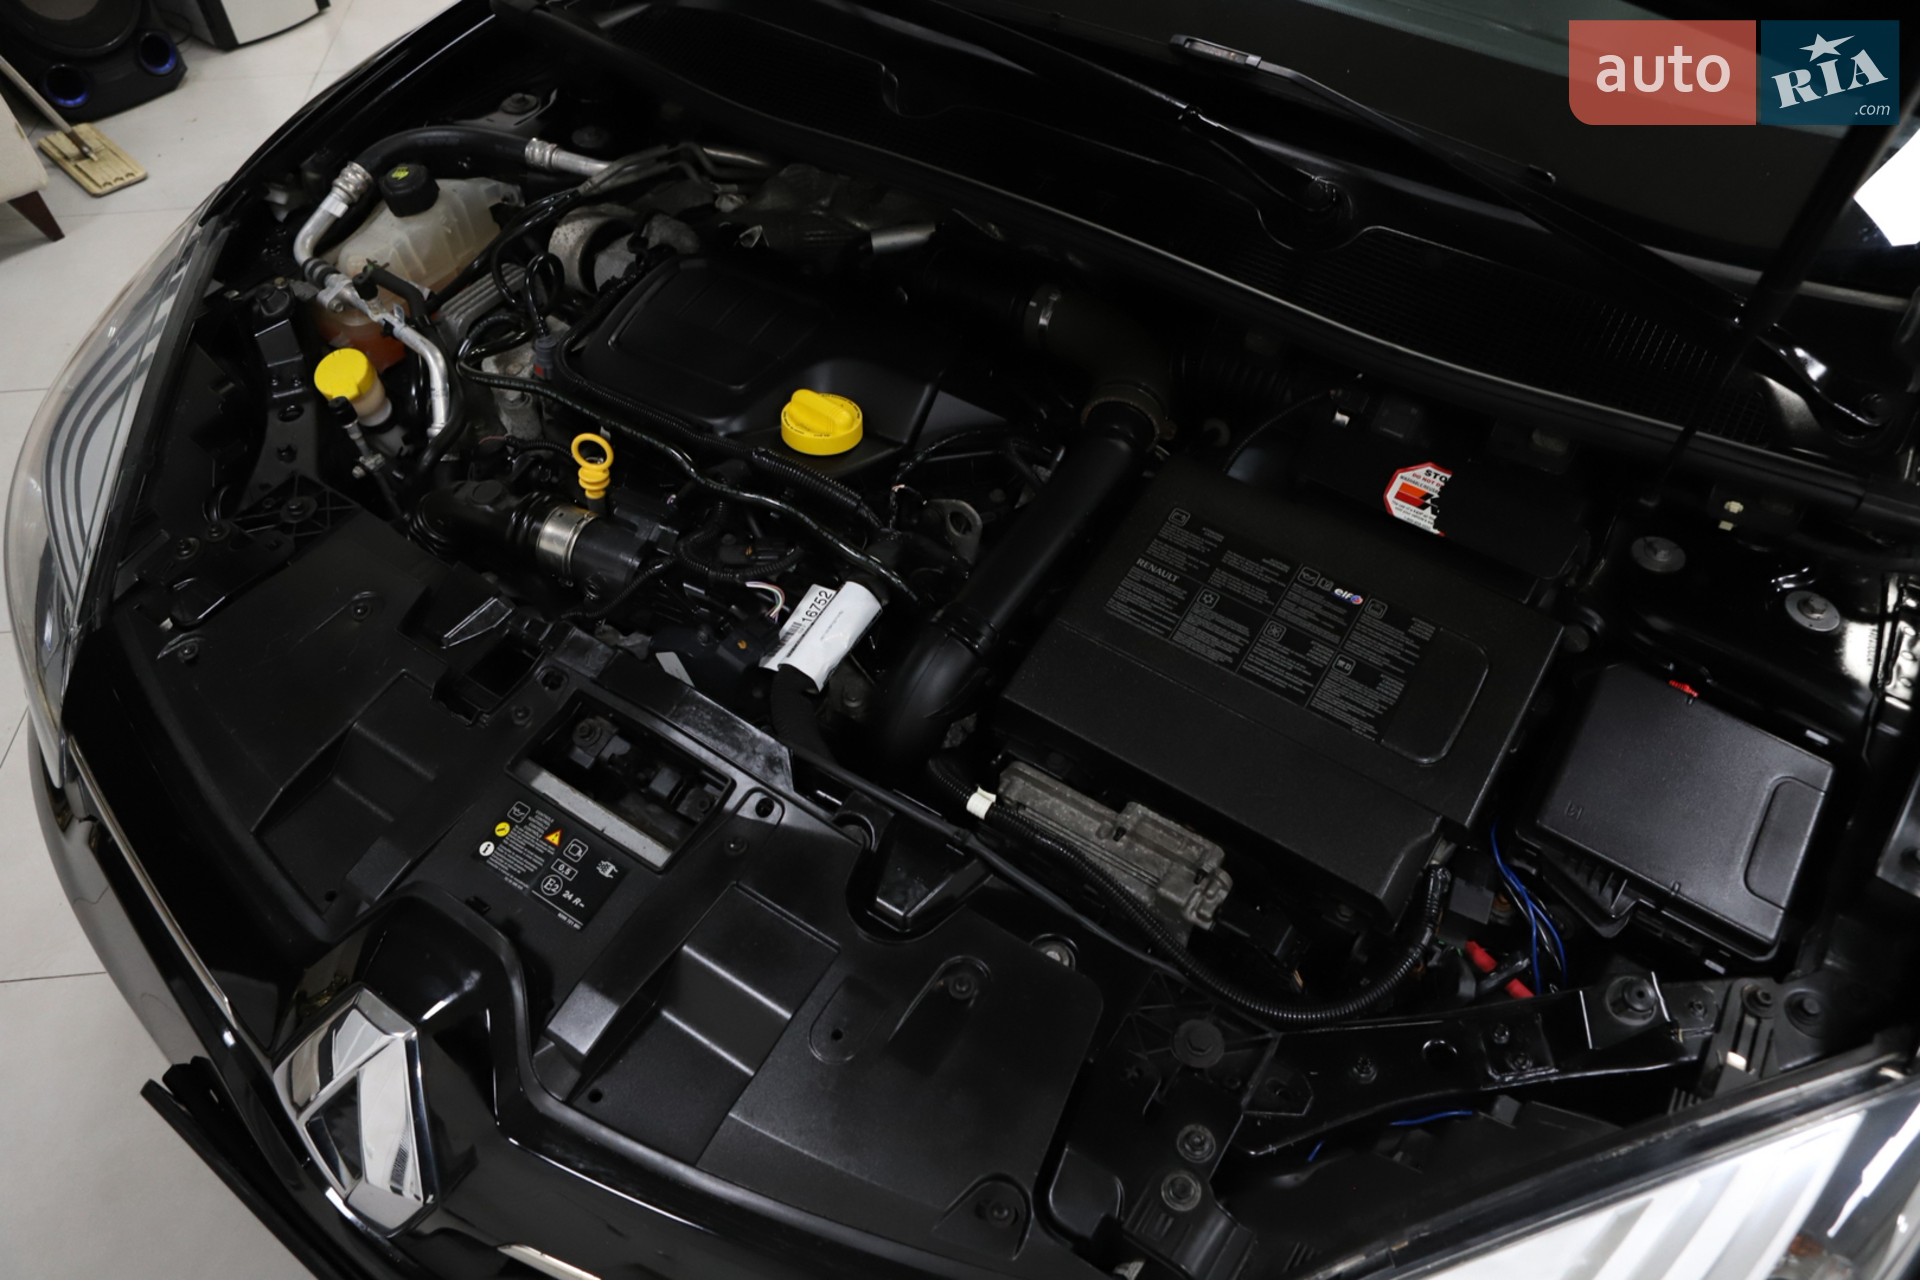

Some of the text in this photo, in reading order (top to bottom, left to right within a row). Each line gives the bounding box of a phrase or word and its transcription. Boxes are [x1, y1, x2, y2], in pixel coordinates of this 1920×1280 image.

[1422, 476, 1435, 484] NOT
[1135, 557, 1180, 582] RENAULT
[1334, 587, 1354, 600] elf
[801, 590, 833, 623] 16752
[544, 877, 560, 892] E2
[562, 889, 573, 901] 24
